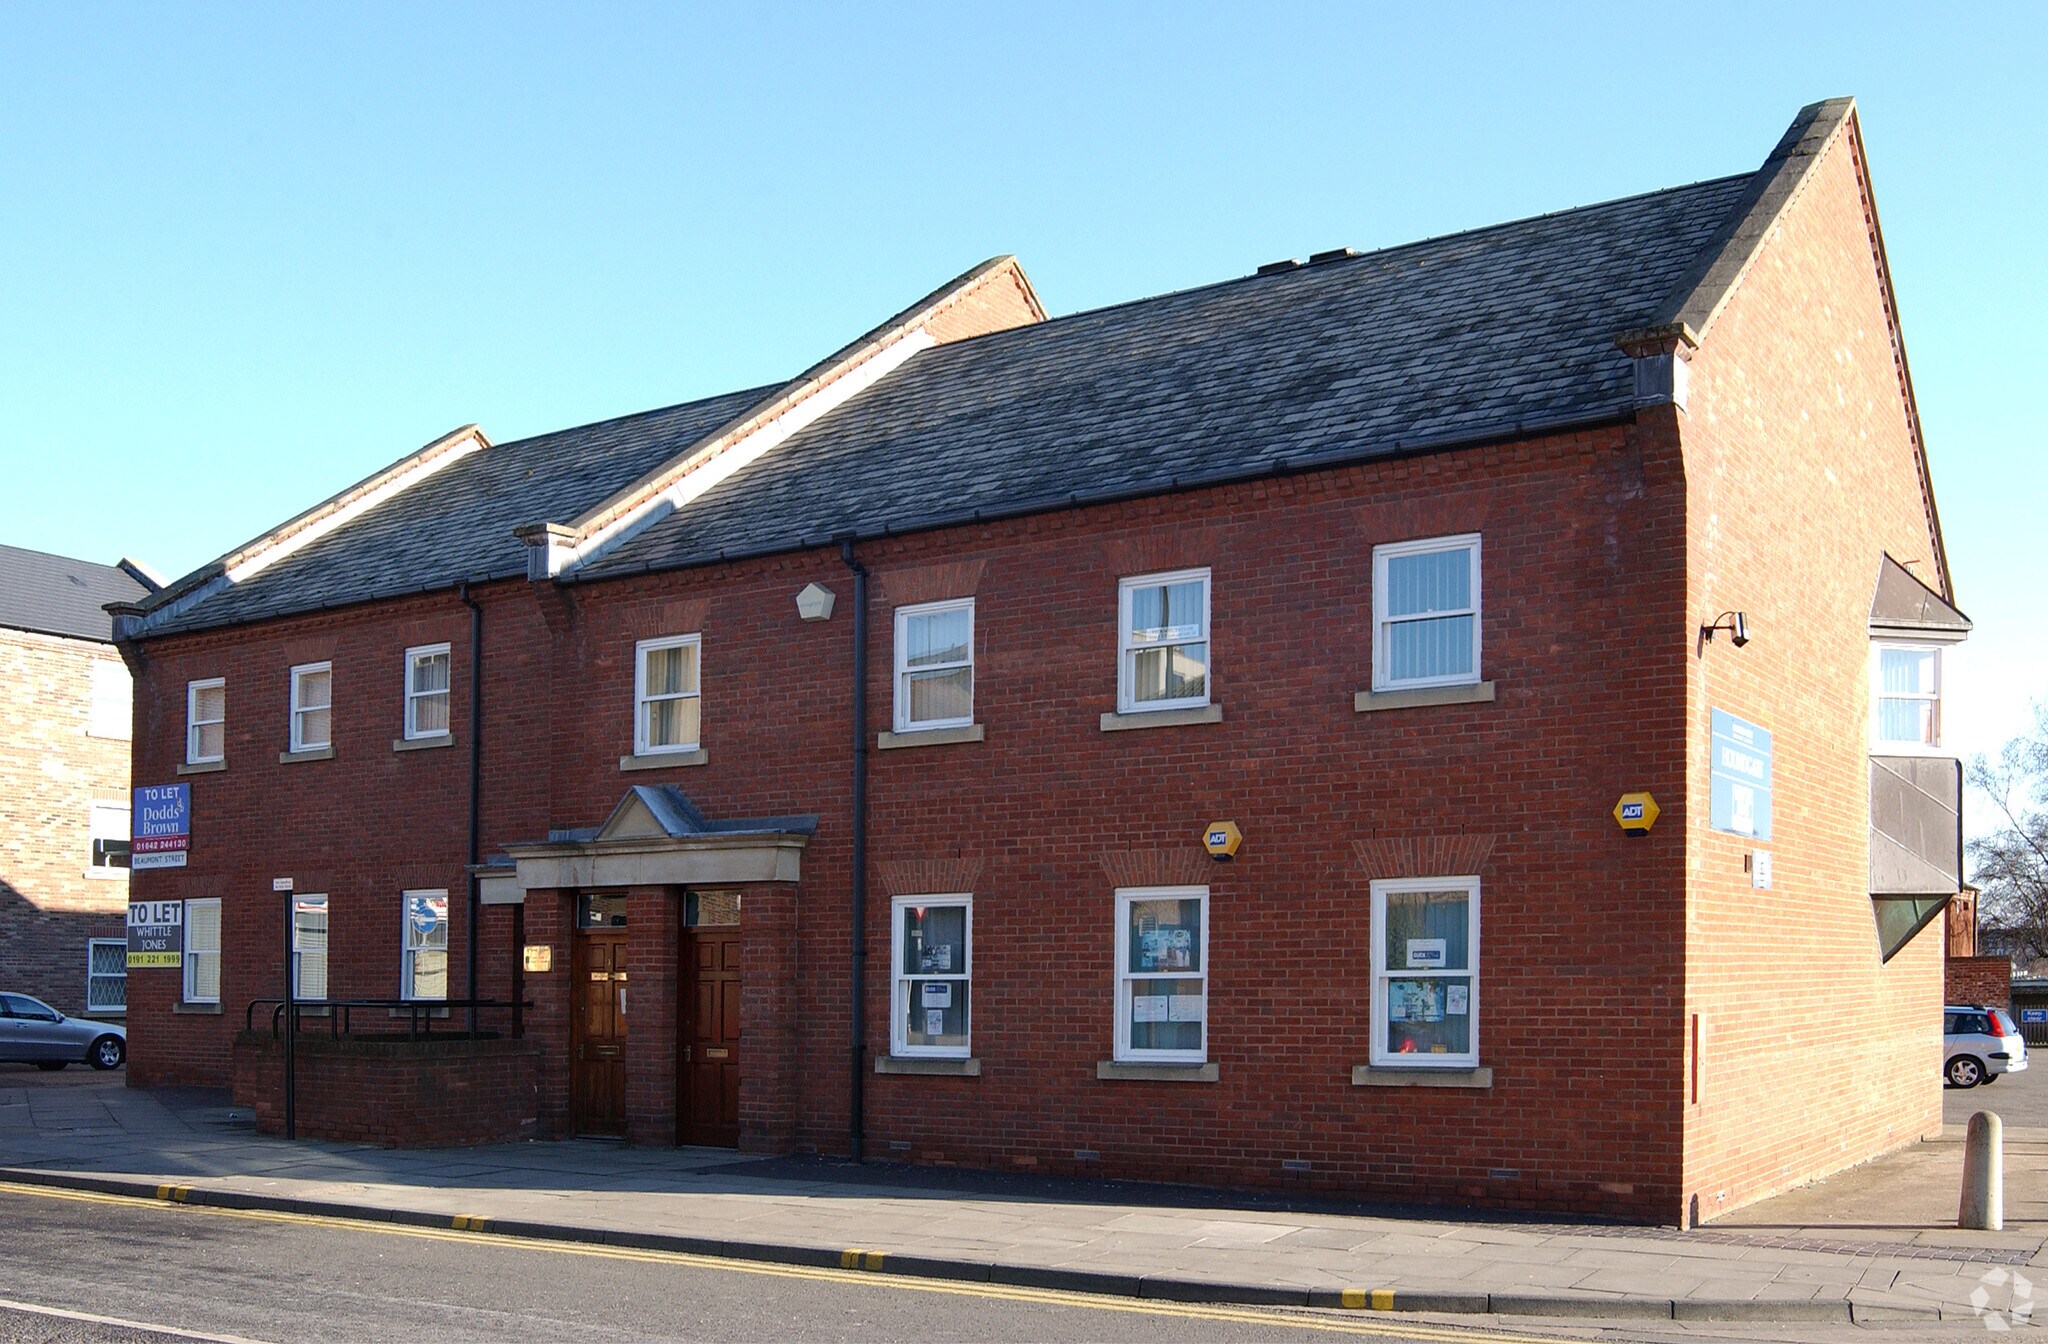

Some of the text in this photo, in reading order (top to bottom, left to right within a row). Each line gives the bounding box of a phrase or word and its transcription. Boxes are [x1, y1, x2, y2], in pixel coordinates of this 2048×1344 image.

[145, 787, 180, 801] TO LET
[143, 804, 180, 821] Dodds
[1622, 806, 1642, 817] ADT
[143, 821, 179, 835] Brown
[1210, 833, 1226, 844] ADT
[134, 854, 184, 865] BEAUMONT STREET
[129, 903, 180, 923] TO LET
[136, 926, 172, 937] WHITTLE
[142, 939, 167, 951] JONES
[128, 954, 180, 964] 0191 221 1999
